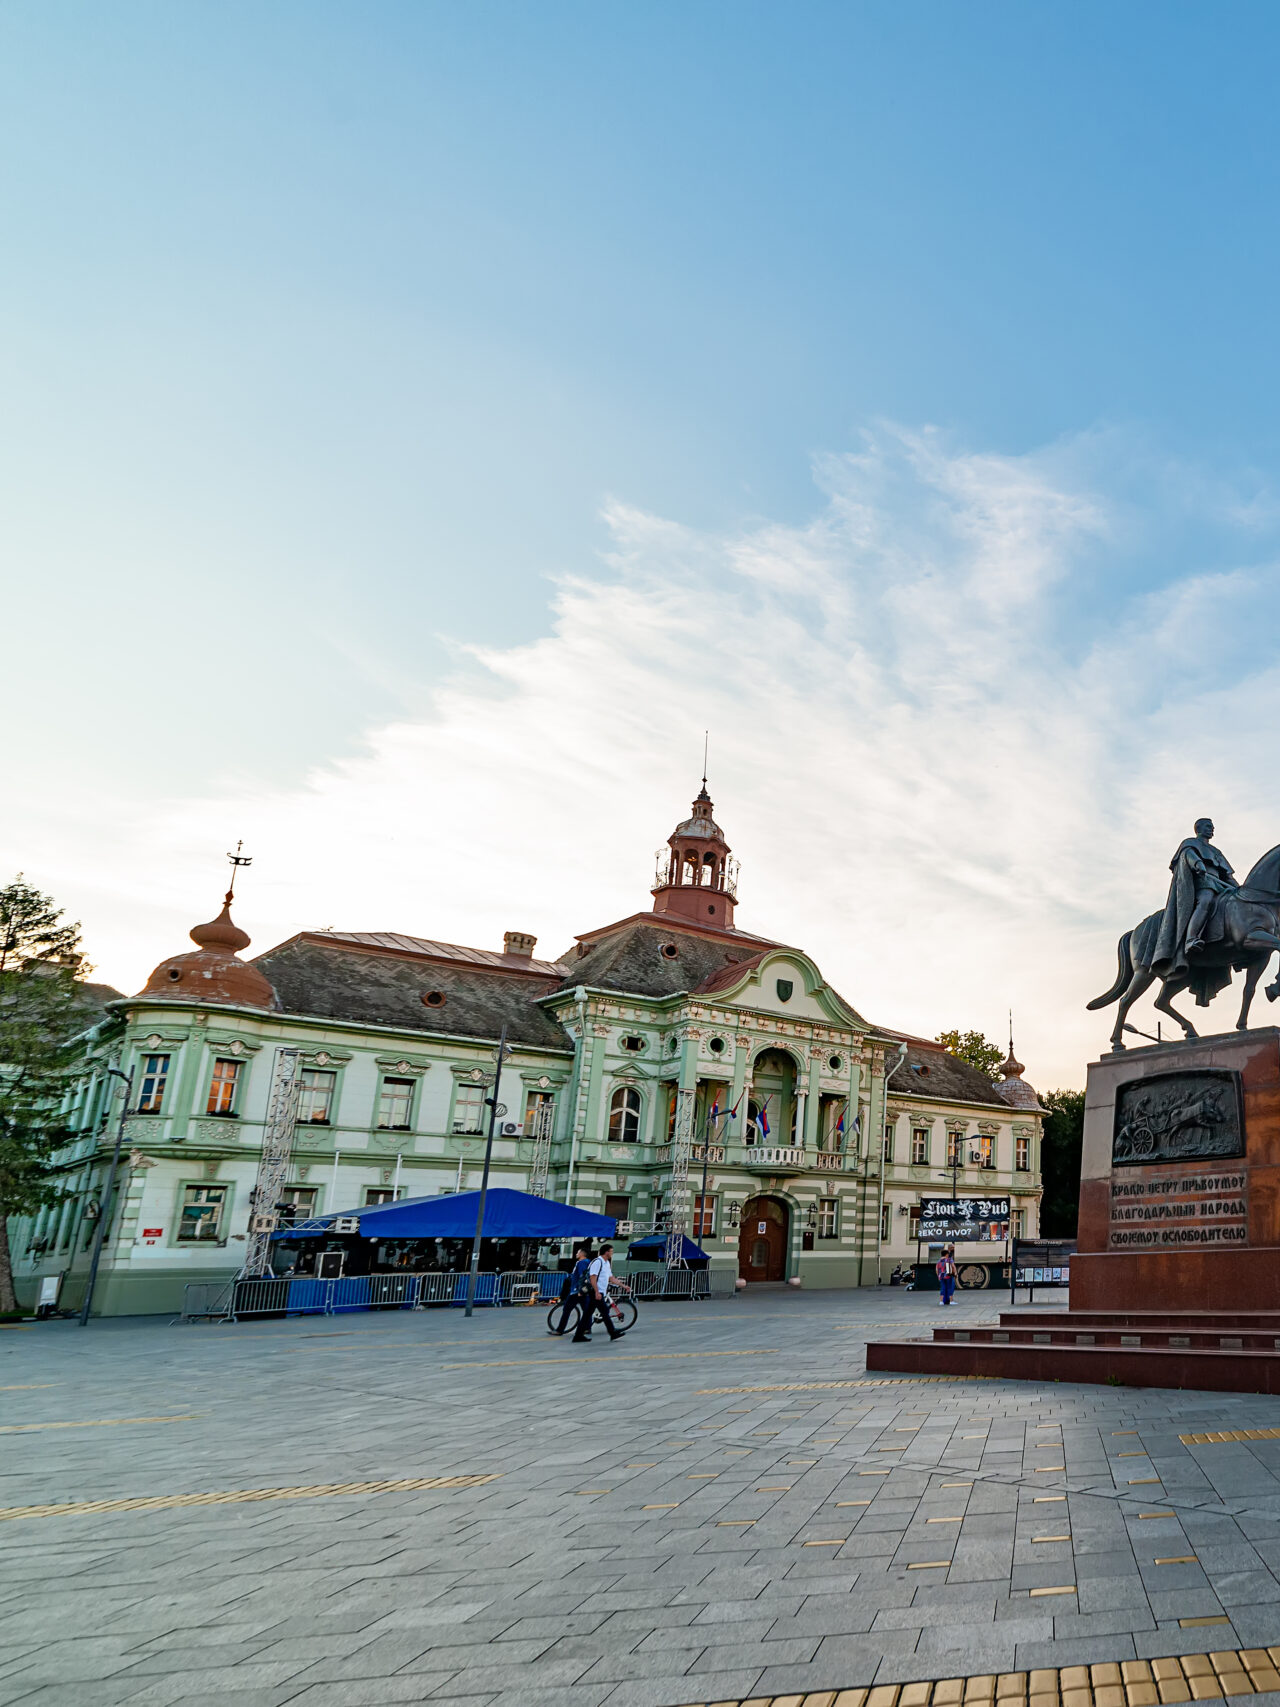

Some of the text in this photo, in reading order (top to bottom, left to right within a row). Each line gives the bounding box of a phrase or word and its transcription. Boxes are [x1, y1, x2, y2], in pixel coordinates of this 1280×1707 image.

[1148, 1180, 1178, 1194] ПЕТРУ
[923, 1200, 1008, 1218] Lion Pub
[923, 1220, 949, 1229] KO JE
[945, 1228, 972, 1237] PIVO?
